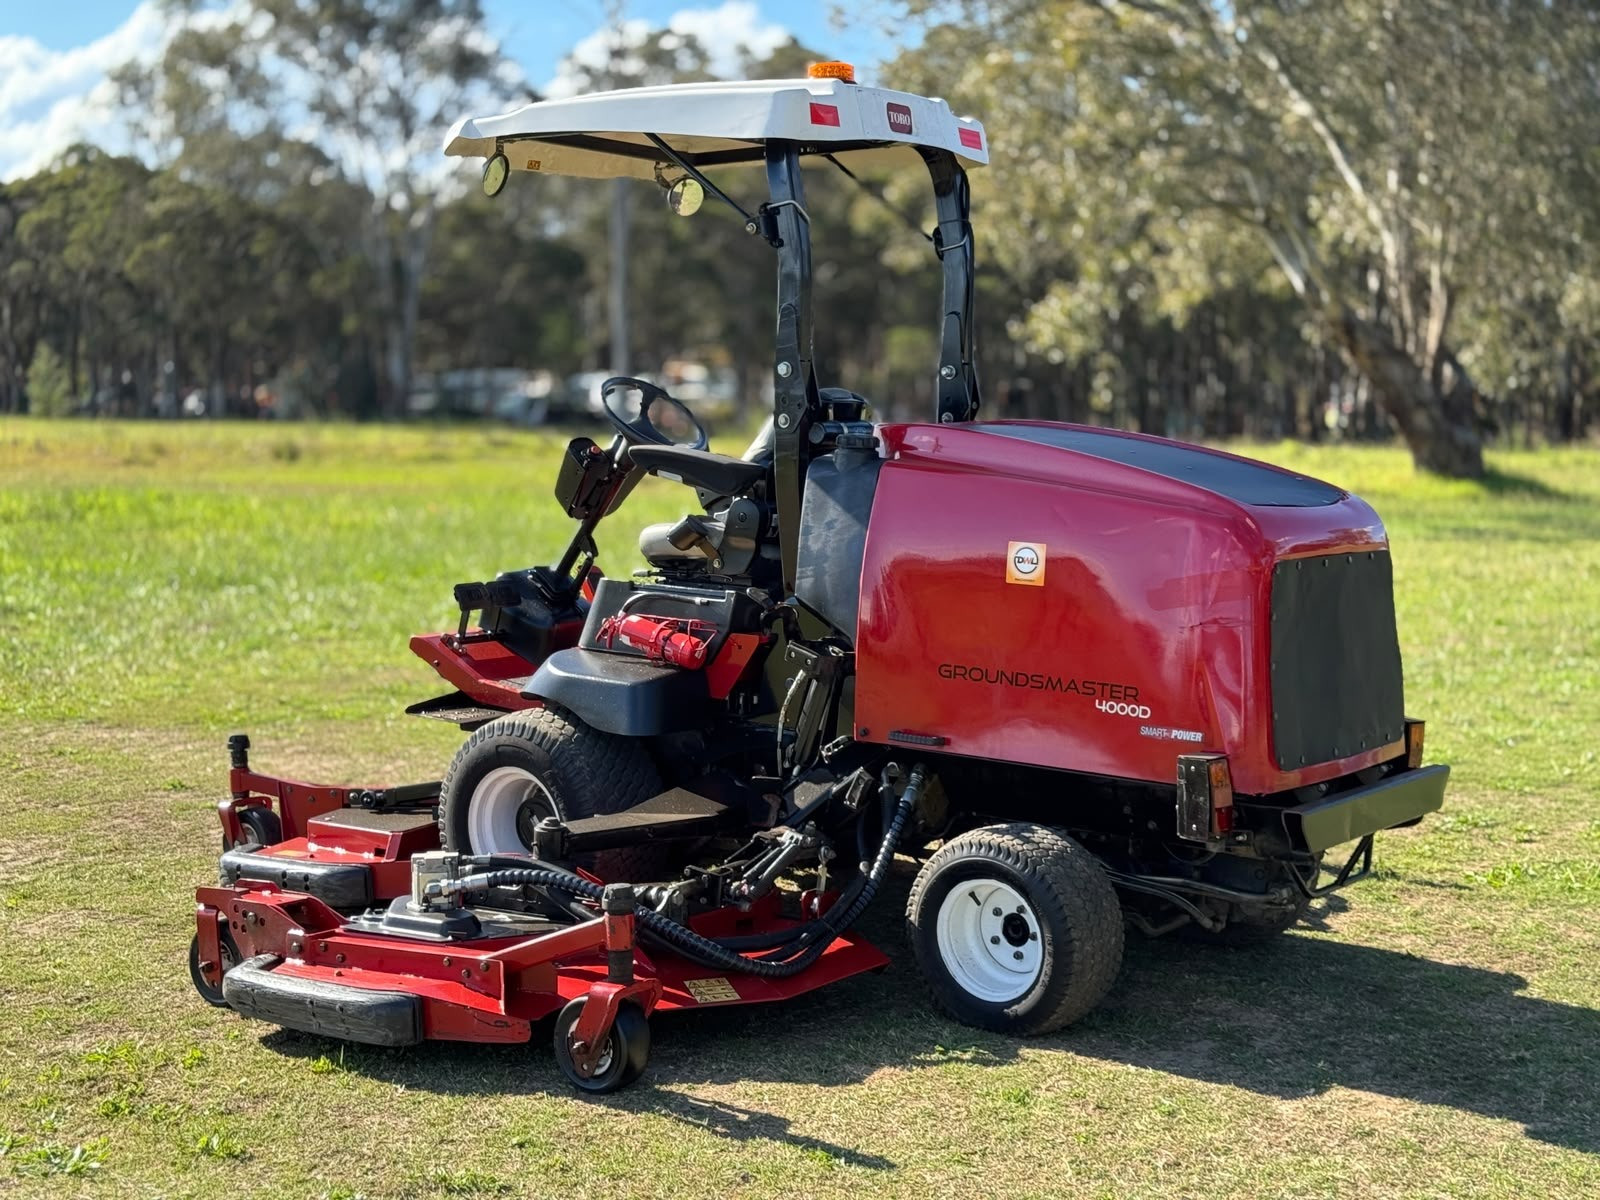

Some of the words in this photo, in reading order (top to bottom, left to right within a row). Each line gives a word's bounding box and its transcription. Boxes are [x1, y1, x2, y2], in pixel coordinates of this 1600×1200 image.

[889, 111, 911, 126] TORO
[938, 664, 1139, 701] GROUNDSMASTER
[1095, 699, 1151, 719] 4000D
[1171, 729, 1203, 742] POWER
